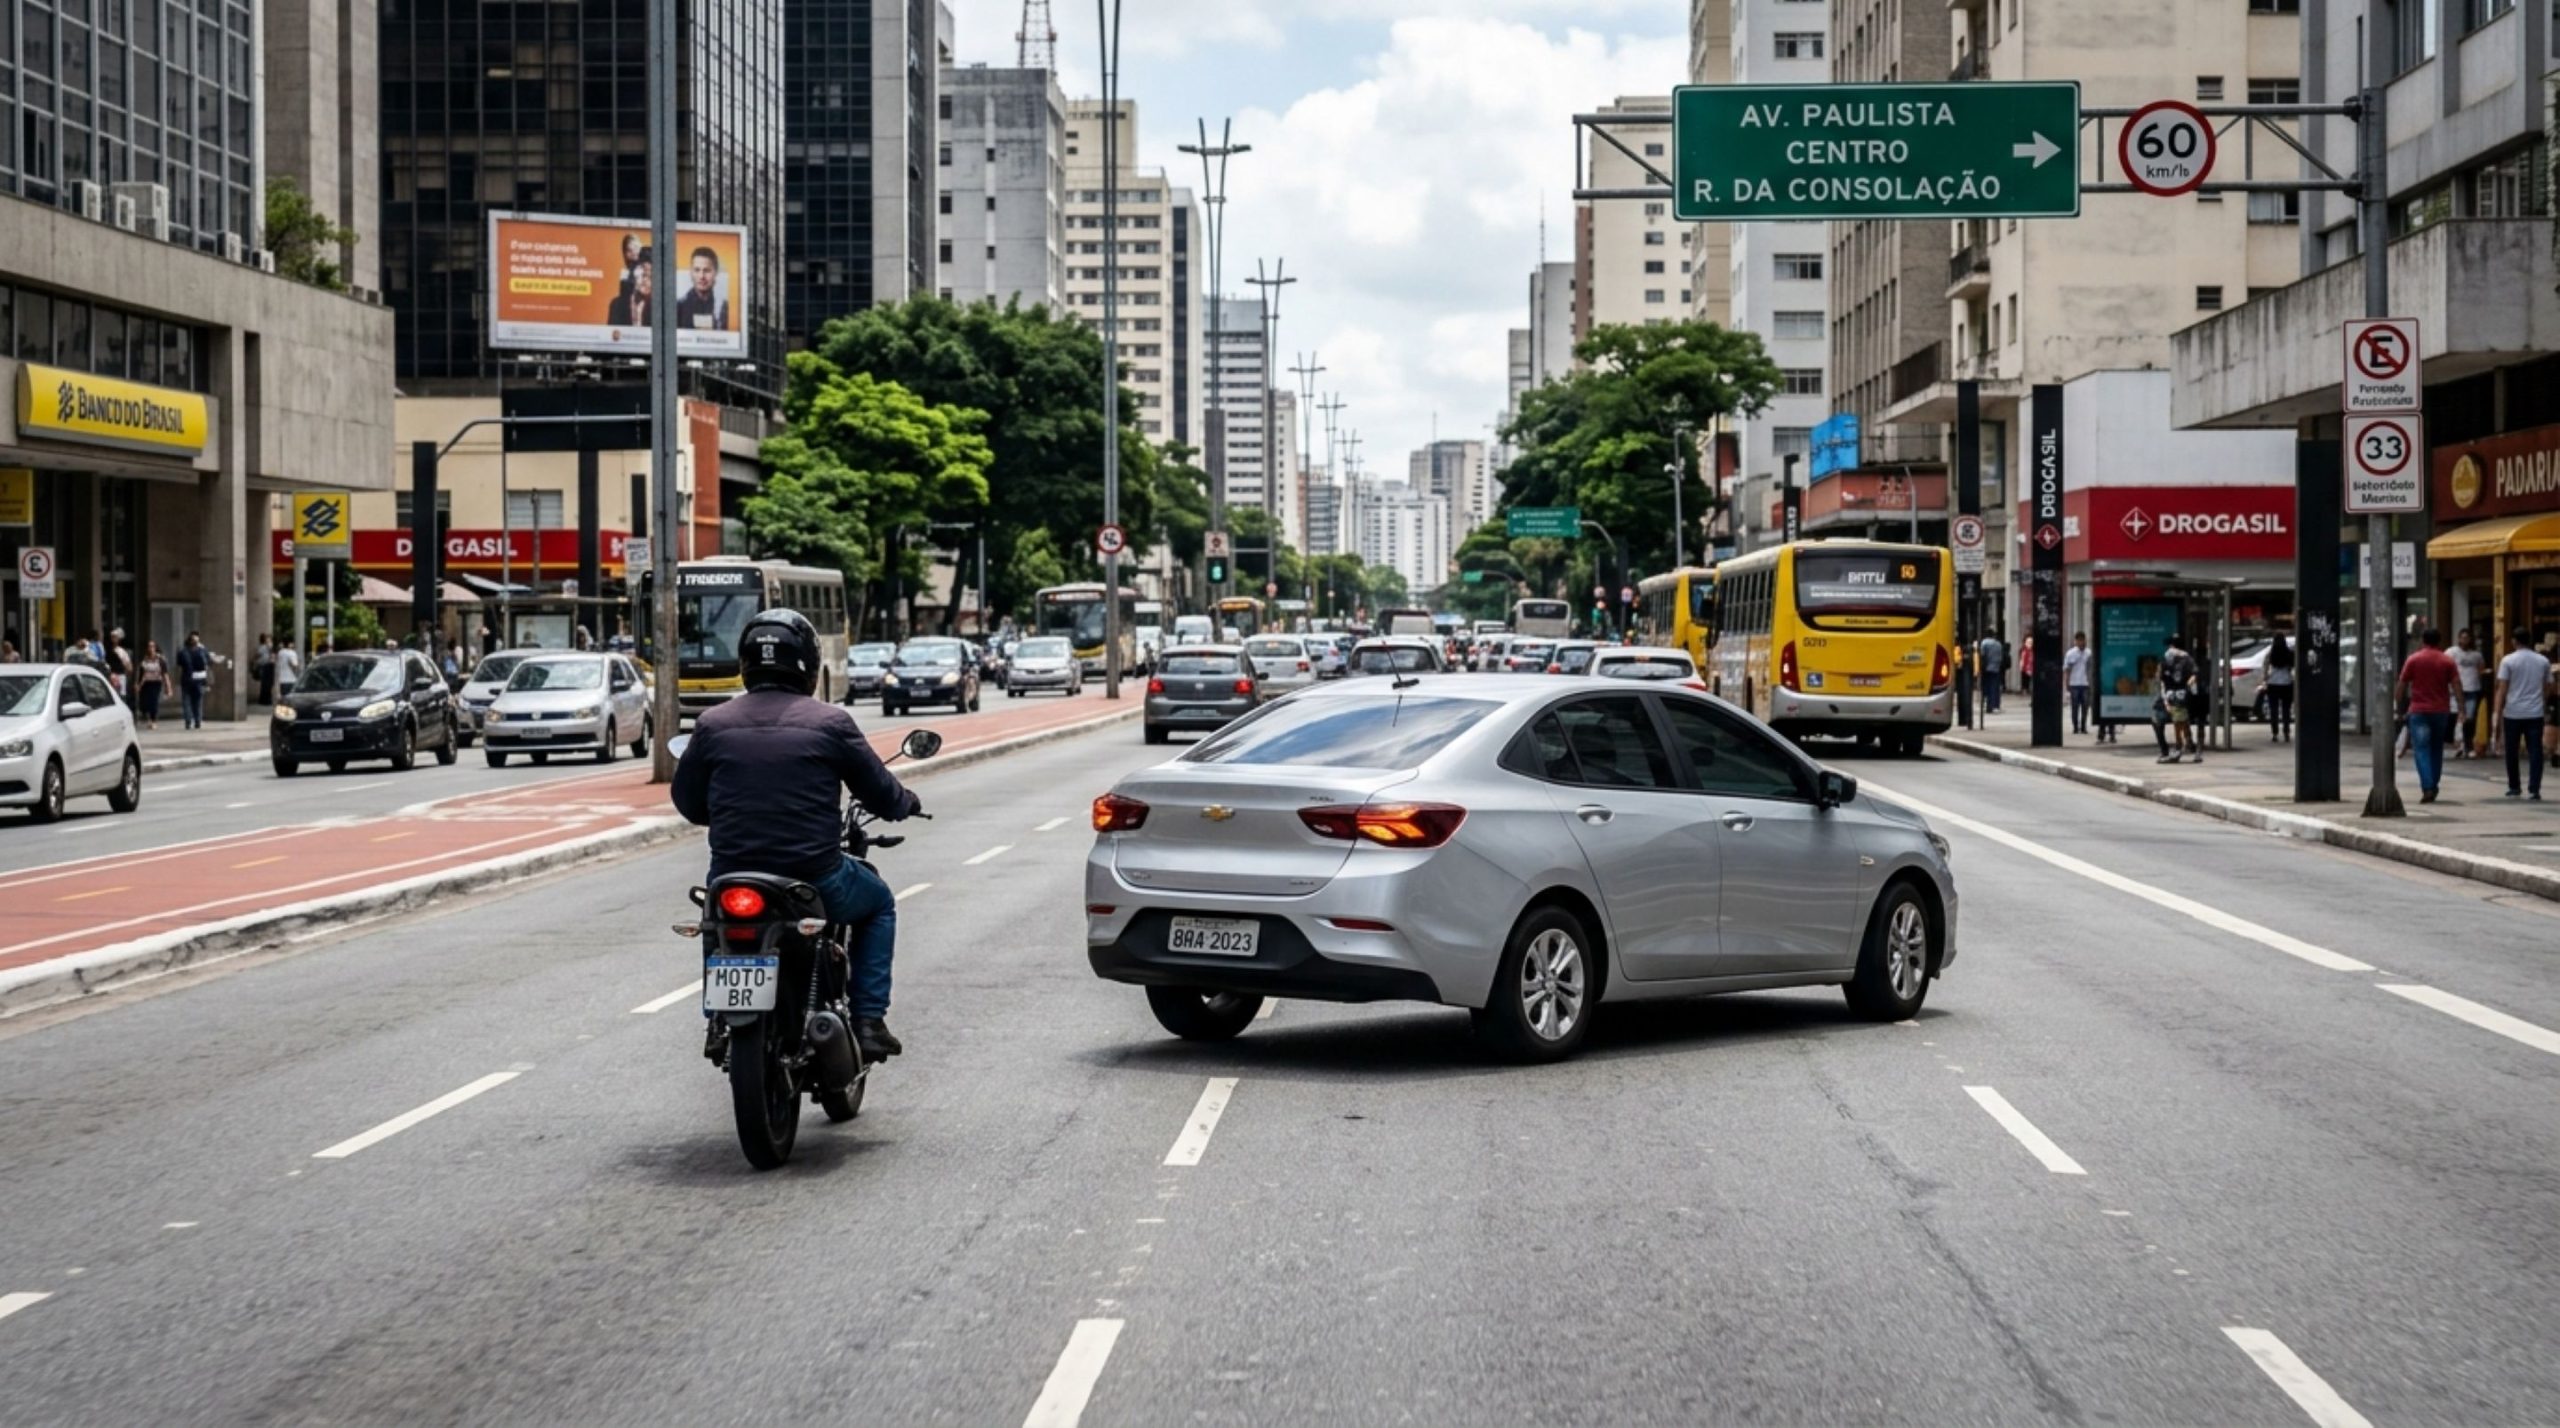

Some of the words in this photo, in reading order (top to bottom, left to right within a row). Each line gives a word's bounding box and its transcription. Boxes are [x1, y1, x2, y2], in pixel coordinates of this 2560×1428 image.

[1740, 104, 1790, 127] AV.
[1802, 102, 1956, 127] PAULISTA
[1786, 140, 1909, 165] CENTRO
[2136, 121, 2197, 160] 60
[1694, 180, 1720, 203] R.
[1733, 178, 1774, 202] DA
[1788, 170, 2001, 206] CONSOLAÇÃO
[143, 398, 185, 434] BRASIL
[2366, 436, 2402, 460] 33
[2158, 513, 2287, 534] DROGASIL
[396, 538, 518, 557] DGASIL
[1210, 931, 1252, 952] 2023
[728, 988, 753, 1007] BR
